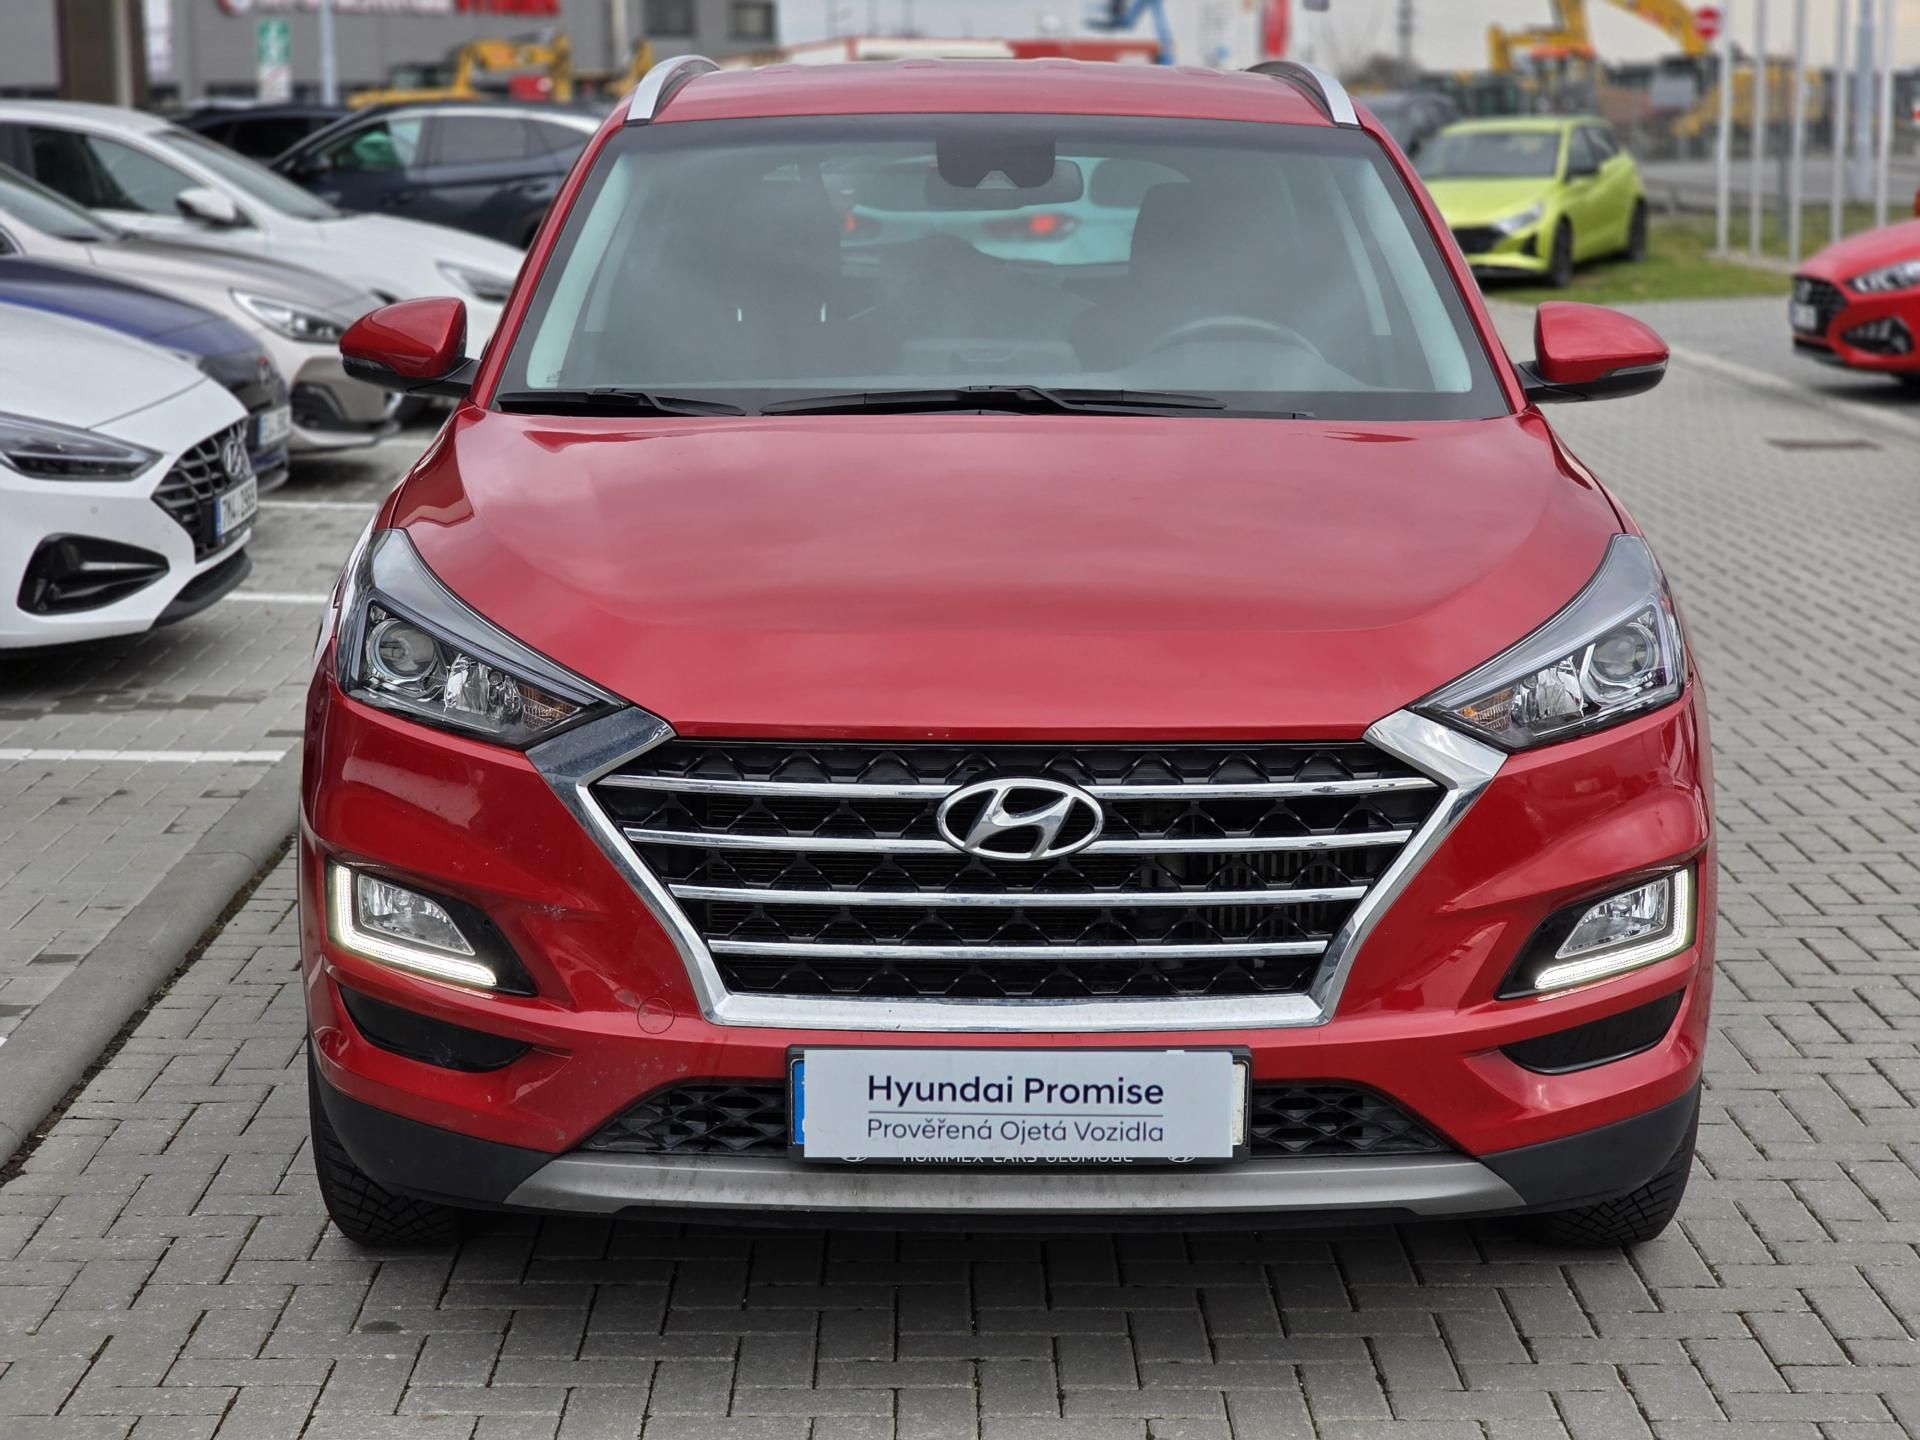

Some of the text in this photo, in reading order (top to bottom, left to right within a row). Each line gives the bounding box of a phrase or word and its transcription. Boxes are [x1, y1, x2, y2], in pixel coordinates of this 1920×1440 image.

[868, 1075, 1164, 1108] Hyundai Promise
[867, 1118, 1164, 1145] Prověřená Ojetá Vozidla
